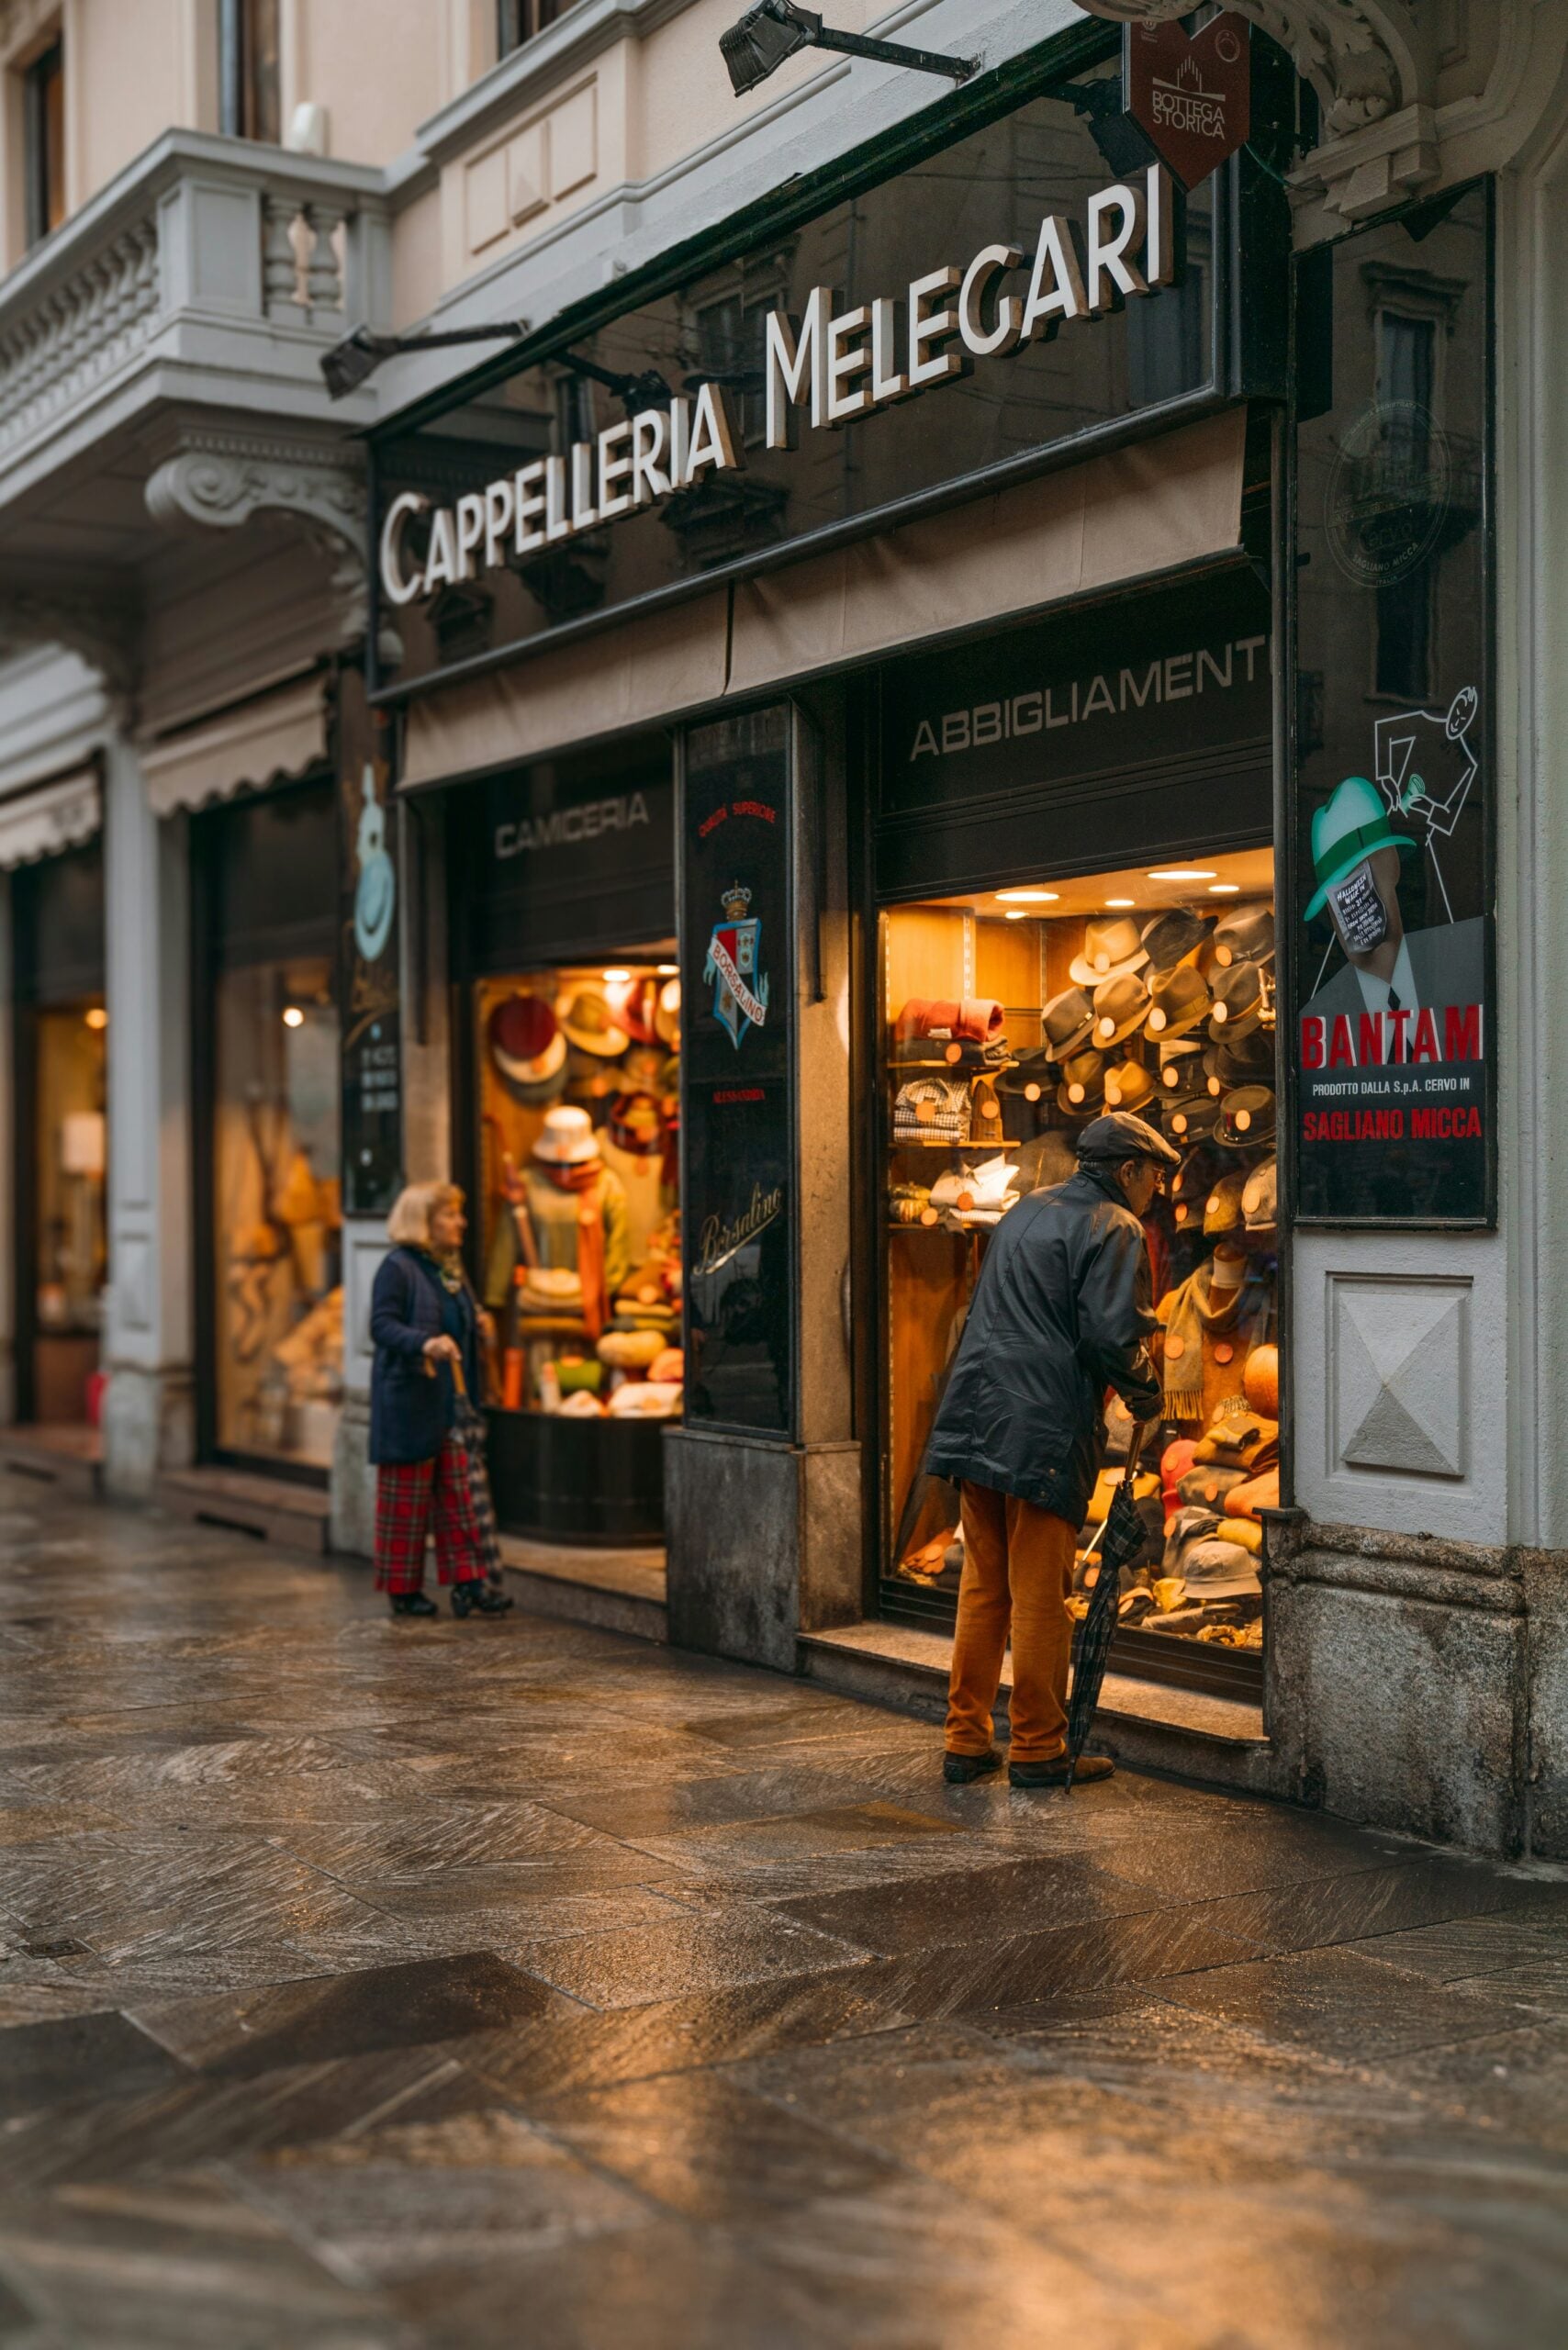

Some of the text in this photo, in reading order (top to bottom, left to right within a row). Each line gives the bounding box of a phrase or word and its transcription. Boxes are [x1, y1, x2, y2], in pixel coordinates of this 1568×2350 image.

[1152, 90, 1226, 125] BOTTEGA
[1152, 107, 1226, 140] STORICA
[379, 162, 1162, 605] CAPPELLERIA MELEGARI
[1352, 543, 1419, 572] SAGLIANO MICCA
[1375, 576, 1398, 586] ITALIA
[910, 633, 1273, 762] ABBIGLIAMENT
[495, 791, 650, 859] CAMICERIA
[1337, 873, 1367, 901] HALLOWEEN
[1345, 890, 1360, 904] WALK
[1360, 883, 1366, 892] IN
[1355, 899, 1362, 907] 31
[712, 943, 764, 1023] BORSALINO
[1302, 1003, 1484, 1069] BANTAM
[1312, 1077, 1471, 1096] PRODOTTO DALLA S.p.A. CERVO IN
[1303, 1106, 1482, 1141] SAGLIANO MICCA
[692, 1181, 781, 1276] Borsalino
